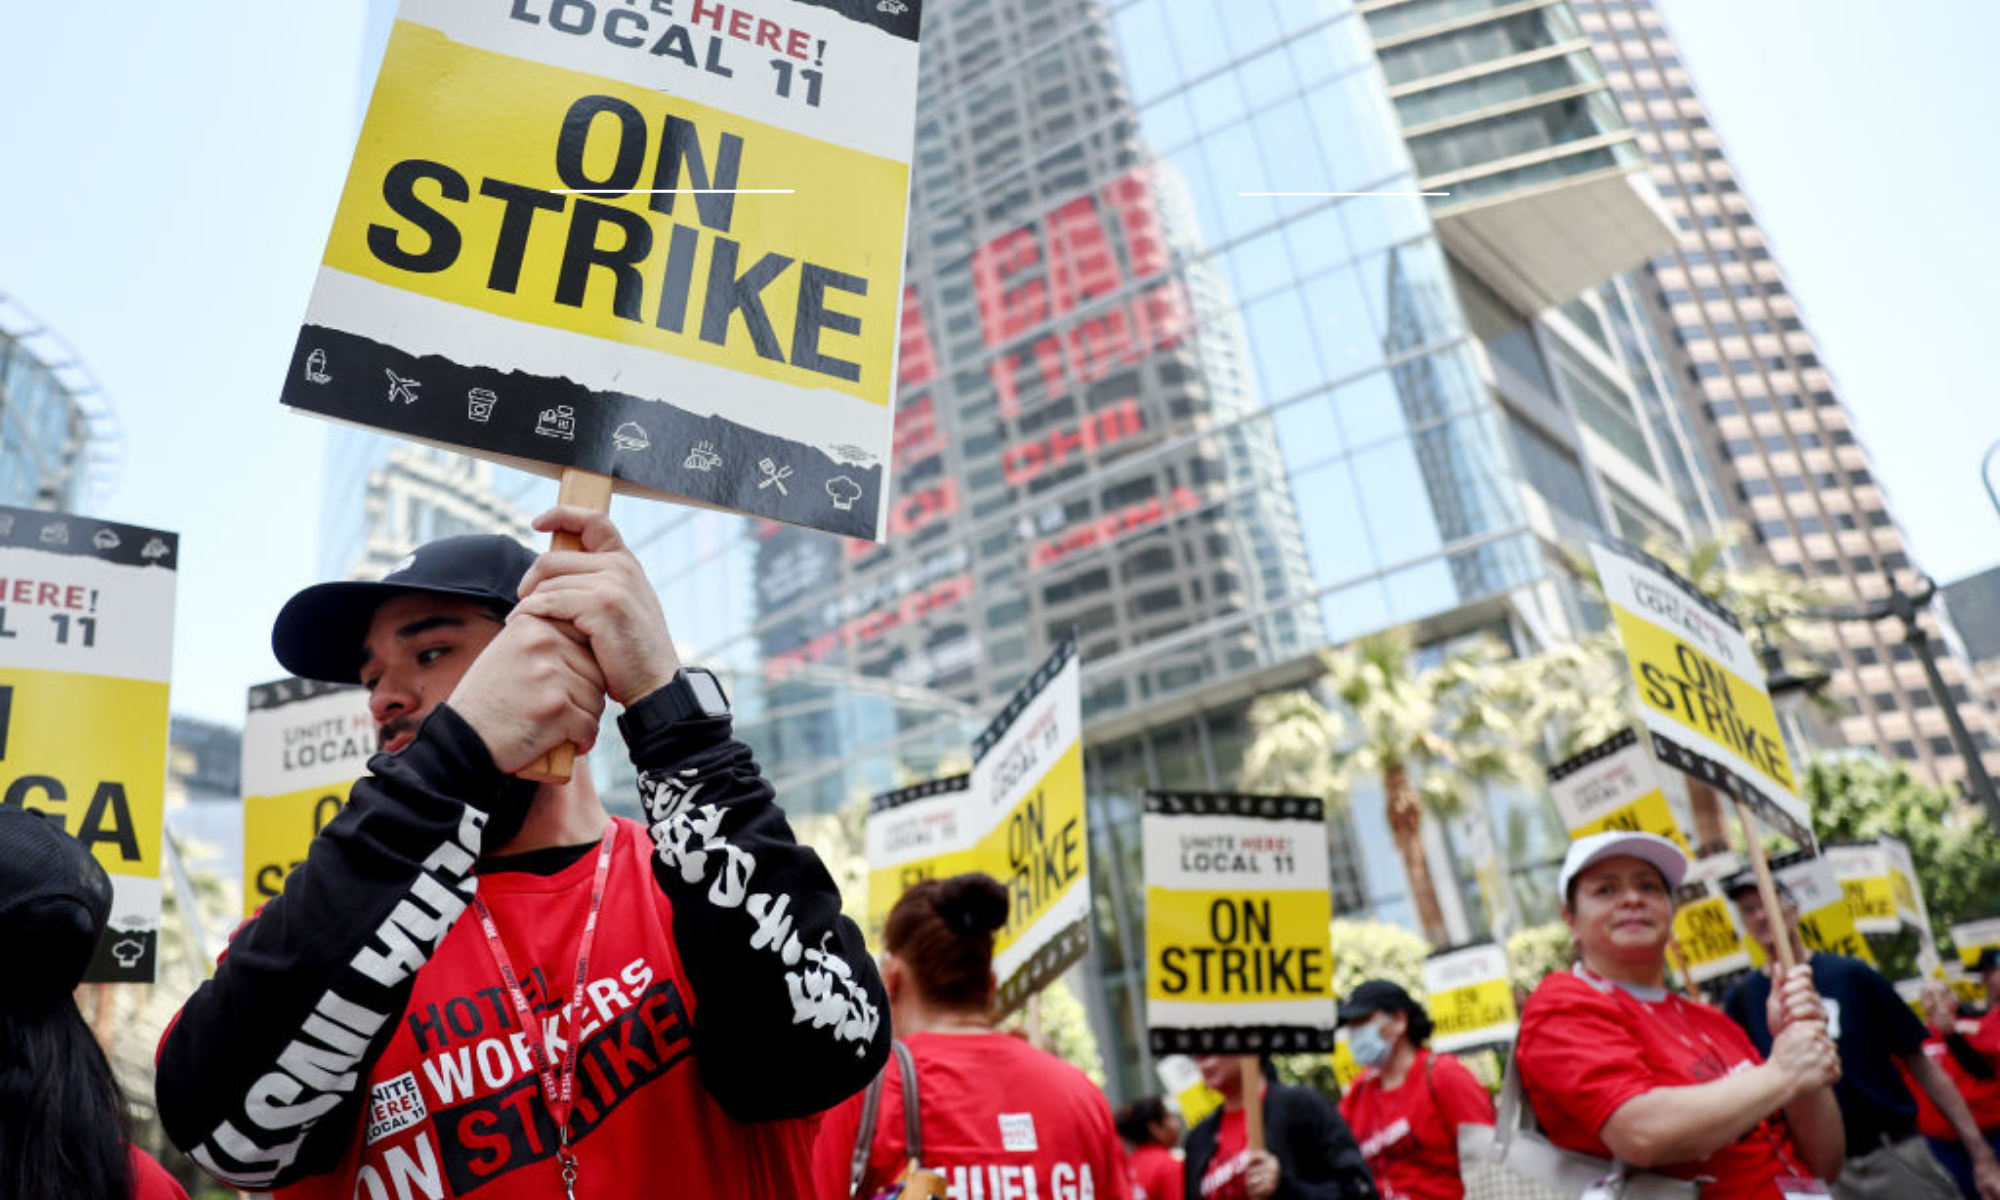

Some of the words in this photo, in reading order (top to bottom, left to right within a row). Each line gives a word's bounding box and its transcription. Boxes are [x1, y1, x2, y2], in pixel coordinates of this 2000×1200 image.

[508, 0, 733, 78] LOCAL
[768, 59, 824, 107] 11
[690, 0, 827, 67] HERE!
[555, 94, 744, 233] ON
[366, 158, 869, 384] STRIKE
[49, 613, 97, 648] 11
[1676, 643, 1735, 712] ON
[284, 718, 346, 745] UNITE
[284, 737, 374, 771] LOCAL
[1640, 661, 1791, 789] STRIKE
[1008, 788, 1044, 870] ON
[1181, 853, 1261, 874] LOCAL
[1274, 855, 1295, 876] 11
[1210, 896, 1271, 946] ON
[1160, 946, 1325, 994] STRIKE
[408, 966, 563, 1053] HOTEL
[422, 957, 654, 1106] WORKERS
[370, 1076, 416, 1106] NITE
[456, 992, 692, 1179] STRIKE
[566, 1043, 577, 1074] UNITE
[411, 1105, 426, 1119] 11
